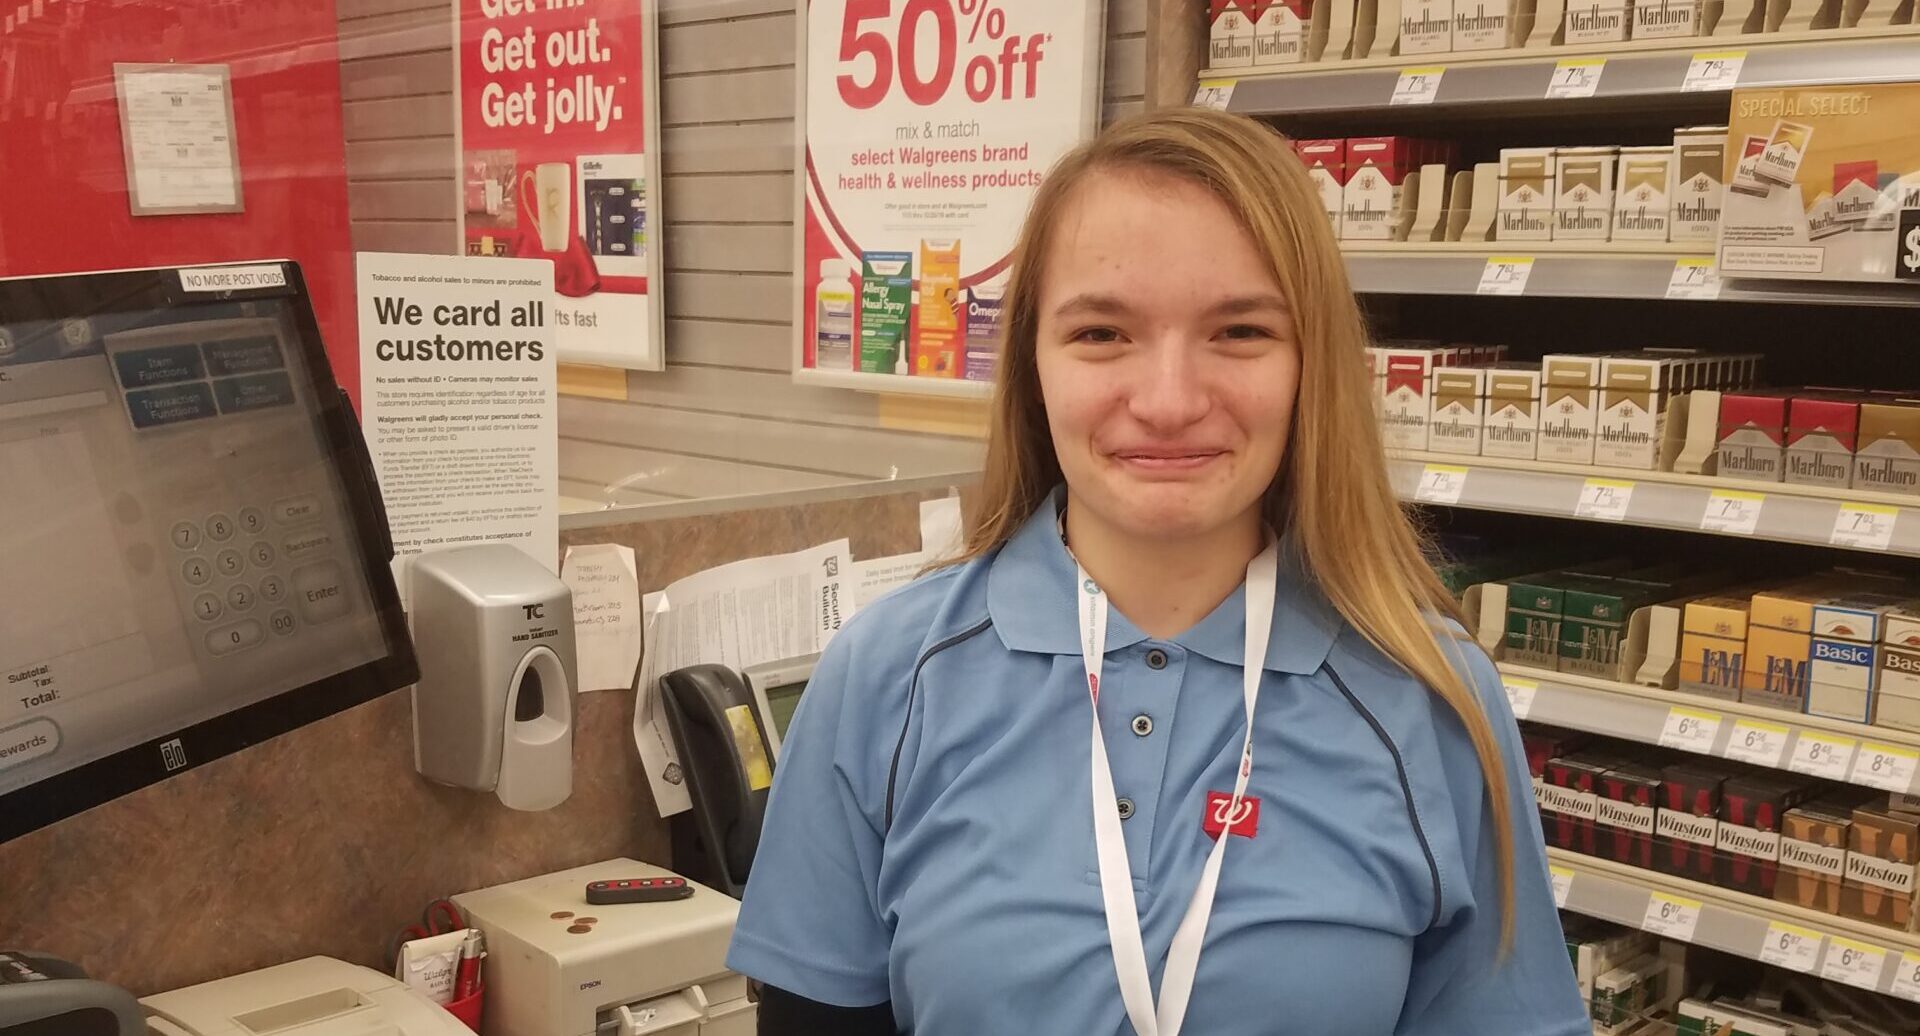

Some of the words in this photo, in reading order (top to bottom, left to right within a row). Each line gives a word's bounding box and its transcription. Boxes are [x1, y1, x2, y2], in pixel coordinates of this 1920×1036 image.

[1404, 8, 1448, 35] Marlboro
[1457, 4, 1504, 31] Marlboro
[1570, 3, 1618, 32] Marlboro
[1638, 0, 1689, 27] Marlboro
[481, 26, 536, 73] Get
[545, 18, 611, 67] out.
[836, 0, 957, 110] 50
[1212, 35, 1250, 60] Marlboro
[1256, 31, 1297, 56] Marlboro
[481, 82, 536, 127] Get
[544, 75, 623, 134] jolly.
[1739, 95, 1805, 118] SPECIAL
[1810, 95, 1872, 116] SELECT
[896, 122, 918, 140] mix
[923, 121, 933, 138] &
[937, 120, 979, 139] match
[851, 147, 894, 166] select
[899, 145, 977, 168] Walgreens
[982, 142, 1028, 162] brand
[839, 172, 882, 190] health
[887, 172, 897, 189] &
[902, 171, 967, 188] wellness
[972, 168, 1042, 191] products
[1503, 208, 1545, 230] Marlboro
[1559, 206, 1602, 230] Marlboro
[1618, 206, 1664, 230] Marlboro
[187, 275, 202, 287] NO
[204, 273, 232, 287] MORE
[233, 273, 256, 286] POST
[257, 272, 284, 285] VOIDS
[372, 273, 401, 283] Tobacco
[403, 275, 416, 283] and
[418, 276, 442, 284] alcohol
[444, 276, 462, 284] sales
[508, 279, 541, 287] prohibited
[863, 282, 889, 298] Allergy
[373, 297, 423, 325] We
[433, 300, 500, 326] card
[511, 300, 544, 327] all
[574, 309, 598, 328] fast
[862, 298, 886, 310] Nasal
[886, 299, 905, 314] Spray
[376, 334, 544, 361] customers
[138, 366, 189, 381] Functions
[148, 357, 173, 370] Item
[376, 376, 386, 384] No
[388, 376, 405, 384] sales
[407, 375, 433, 383] without
[448, 375, 478, 383] Cameras
[479, 377, 493, 385] may
[494, 375, 520, 383] monitor
[522, 375, 538, 383] sales
[143, 394, 200, 410] Transaction
[150, 404, 200, 420] Functions
[377, 399, 410, 407] customers
[377, 415, 414, 424] Walgreens
[415, 414, 427, 422] will
[428, 414, 448, 423] gladly
[450, 414, 473, 422] accept
[474, 414, 489, 422] your
[491, 413, 520, 421] personal
[1384, 407, 1423, 426] Marlboro
[1434, 418, 1475, 438] Marlboro
[1544, 418, 1589, 440] Marlboro
[1488, 422, 1531, 443] Marlboro
[1602, 422, 1649, 444] Marlboro
[1722, 447, 1775, 472] Marlboro
[1790, 452, 1845, 479] Marlboro
[1859, 459, 1917, 485] Marlboro
[181, 529, 190, 542] 7
[215, 522, 225, 535] 8
[248, 515, 257, 527] 9
[413, 539, 421, 547] by
[423, 537, 443, 545] check
[445, 534, 483, 543] constitutes
[485, 531, 523, 540] acceptance
[525, 530, 532, 538] of
[192, 564, 201, 577] 4
[226, 556, 235, 569] 5
[258, 549, 267, 561] 6
[204, 602, 212, 614] 1
[237, 592, 246, 605] 2
[268, 583, 278, 596] 3
[306, 584, 339, 603] Enter
[822, 585, 830, 631] Bulletin
[830, 582, 842, 631] Security
[522, 603, 545, 620] TC
[231, 631, 241, 644] 0
[275, 615, 292, 630] 00
[512, 633, 529, 642] HAND
[530, 628, 558, 641] SANITIZER
[1582, 625, 1620, 664] L&M
[1814, 642, 1869, 664] Basic
[1701, 647, 1742, 688] L&M
[1764, 654, 1808, 698] L&M
[33, 675, 54, 688] Tax:
[21, 689, 61, 710] Total:
[0, 734, 47, 759] ewards
[1543, 788, 1592, 813] Winston
[1599, 802, 1650, 827] Winston
[1659, 813, 1713, 839] Winston
[1719, 827, 1775, 853] Winston
[1782, 842, 1839, 870] Winston
[1850, 856, 1908, 886] Winston
[579, 979, 602, 991] EPSON
